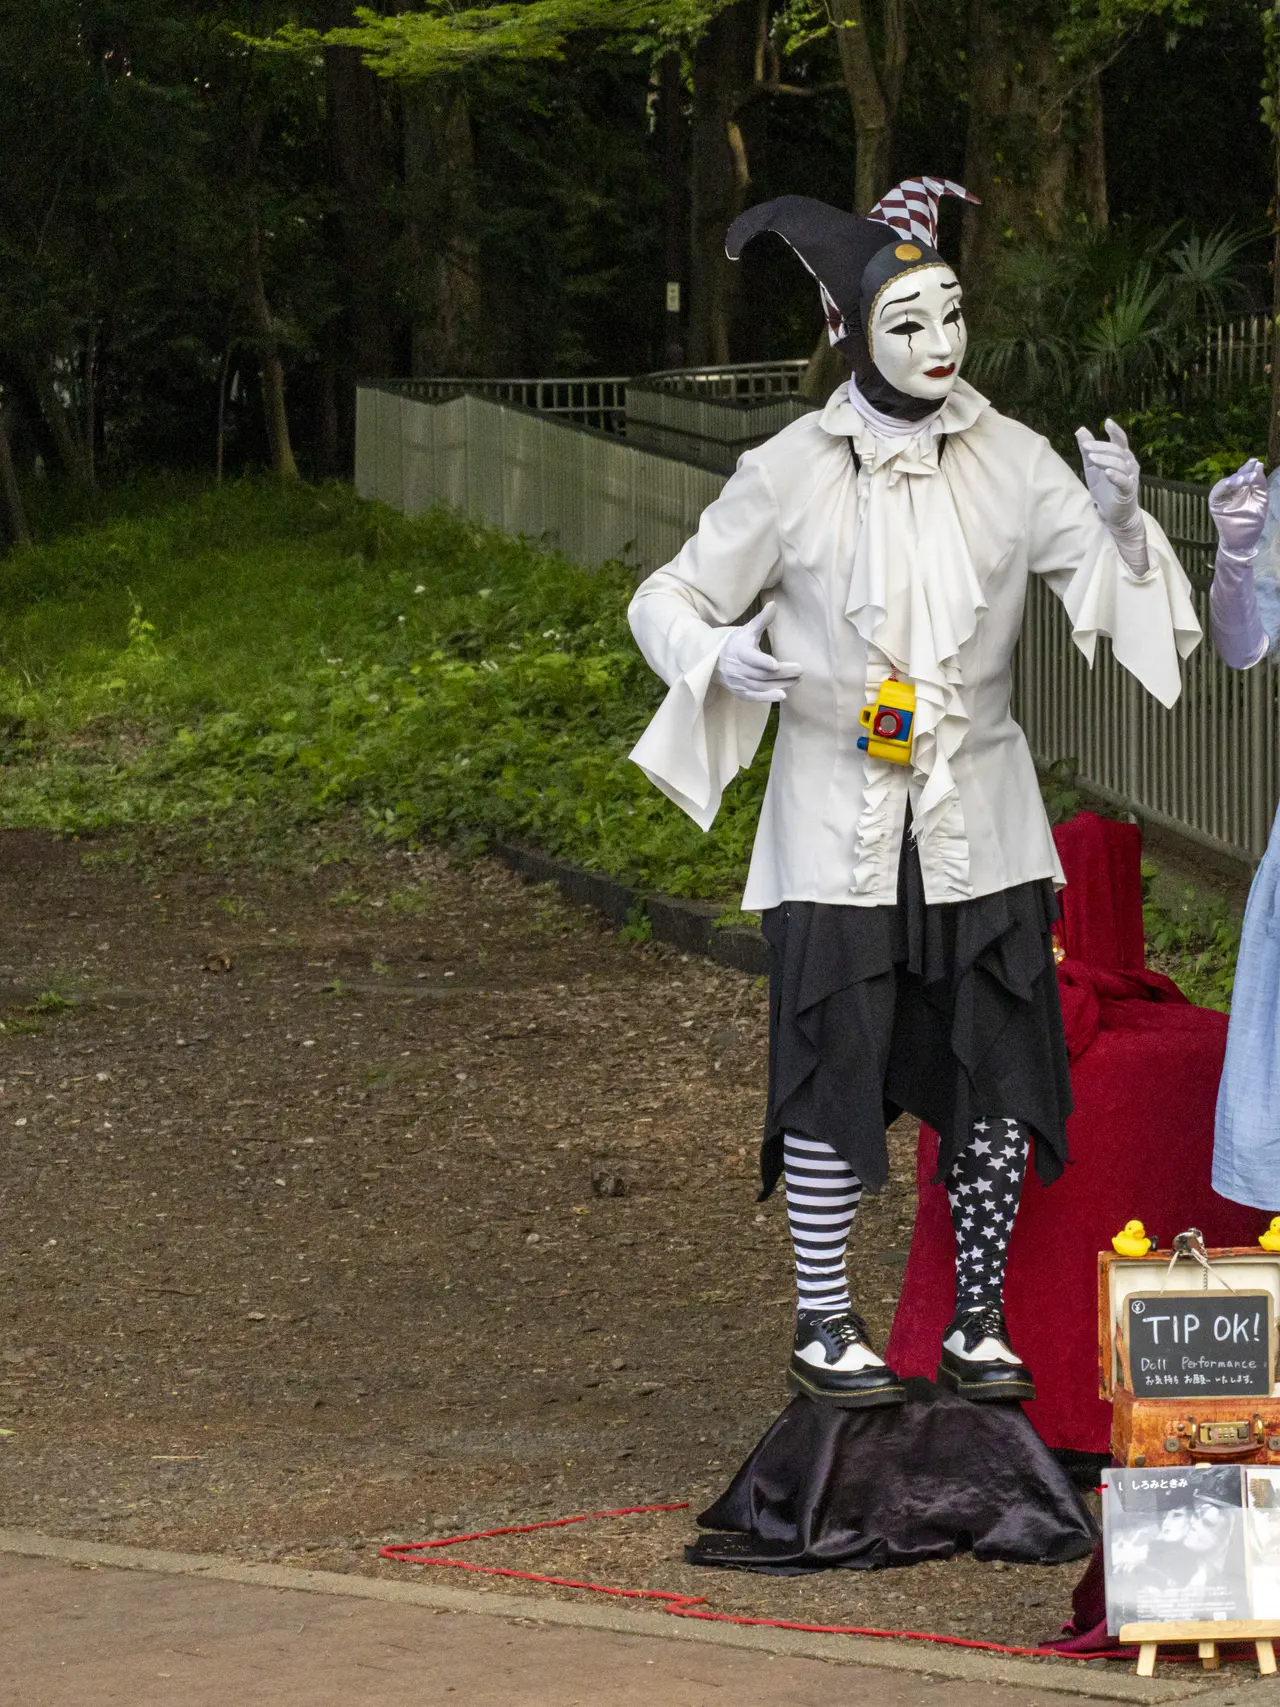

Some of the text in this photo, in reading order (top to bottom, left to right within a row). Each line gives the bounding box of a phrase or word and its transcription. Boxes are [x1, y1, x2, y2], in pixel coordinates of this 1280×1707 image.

[1142, 1312, 1261, 1345] TIP OK!
[1140, 1356, 1257, 1372] Doll Performance
